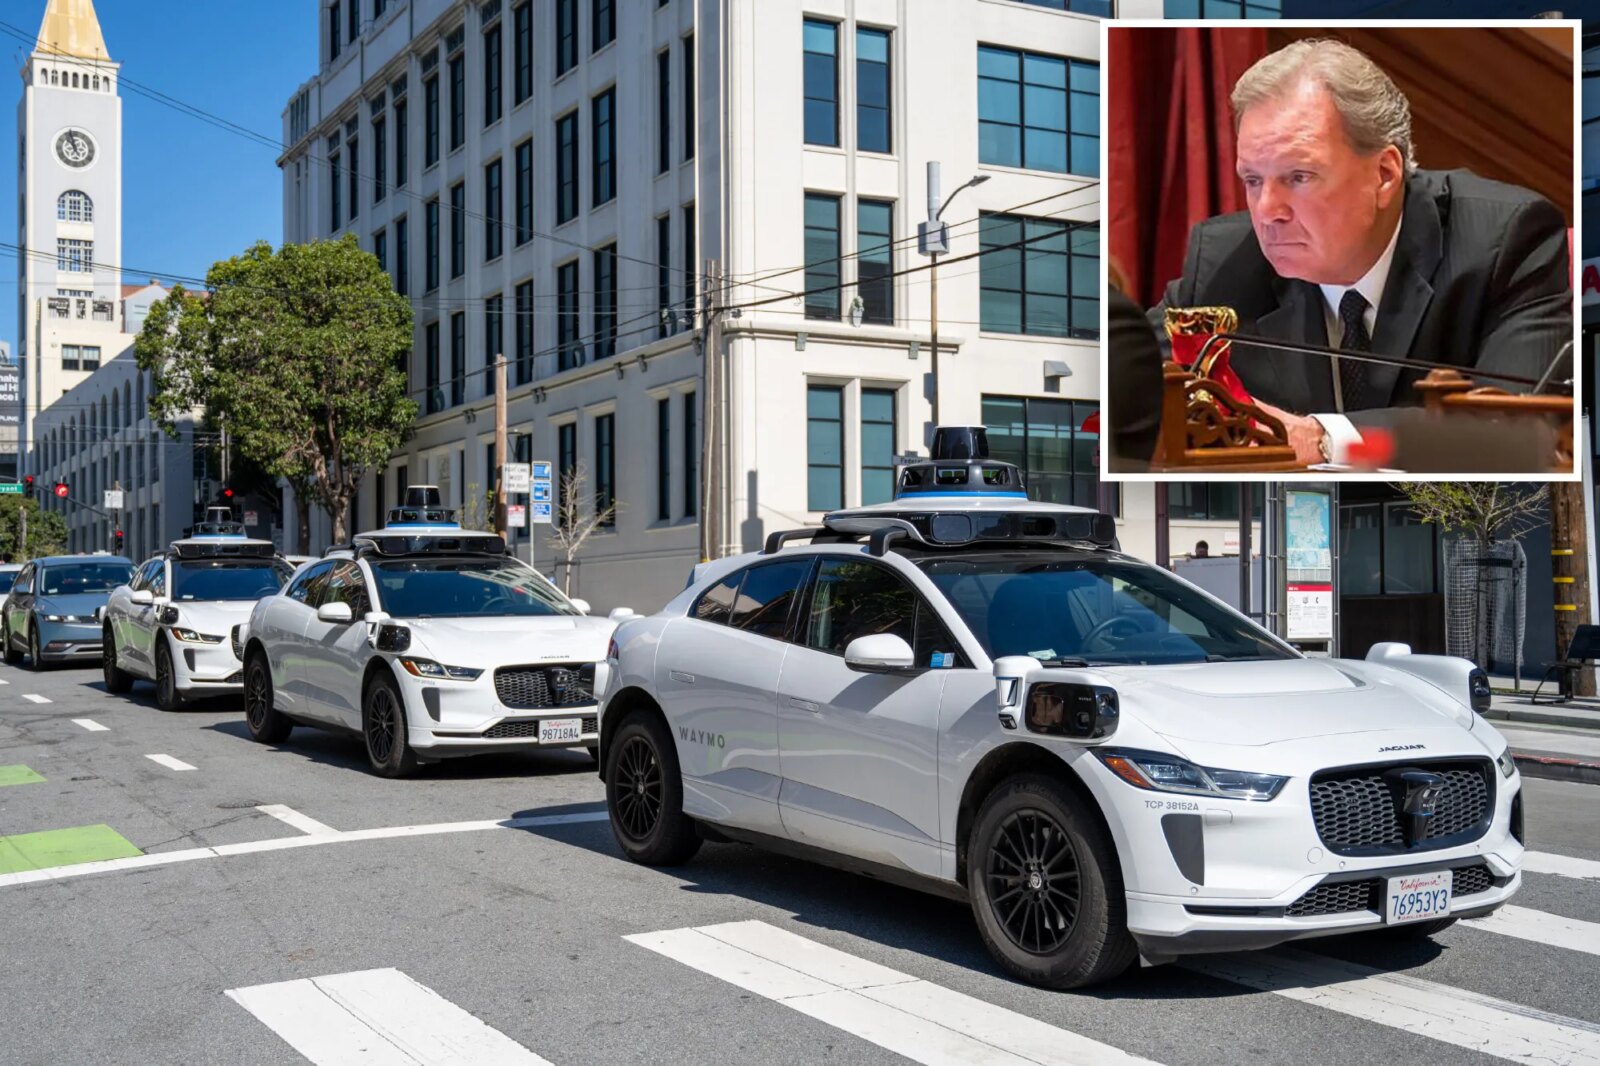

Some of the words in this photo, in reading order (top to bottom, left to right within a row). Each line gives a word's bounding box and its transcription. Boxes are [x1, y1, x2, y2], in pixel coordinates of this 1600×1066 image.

[541, 727, 579, 740] 98718A4
[679, 726, 725, 749] WAYMO
[1378, 744, 1426, 752] JAGUAR
[1144, 800, 1164, 809] TCP
[1166, 801, 1199, 811] 38152A
[1401, 878, 1440, 891] California
[1392, 889, 1448, 917] 76953Y3
